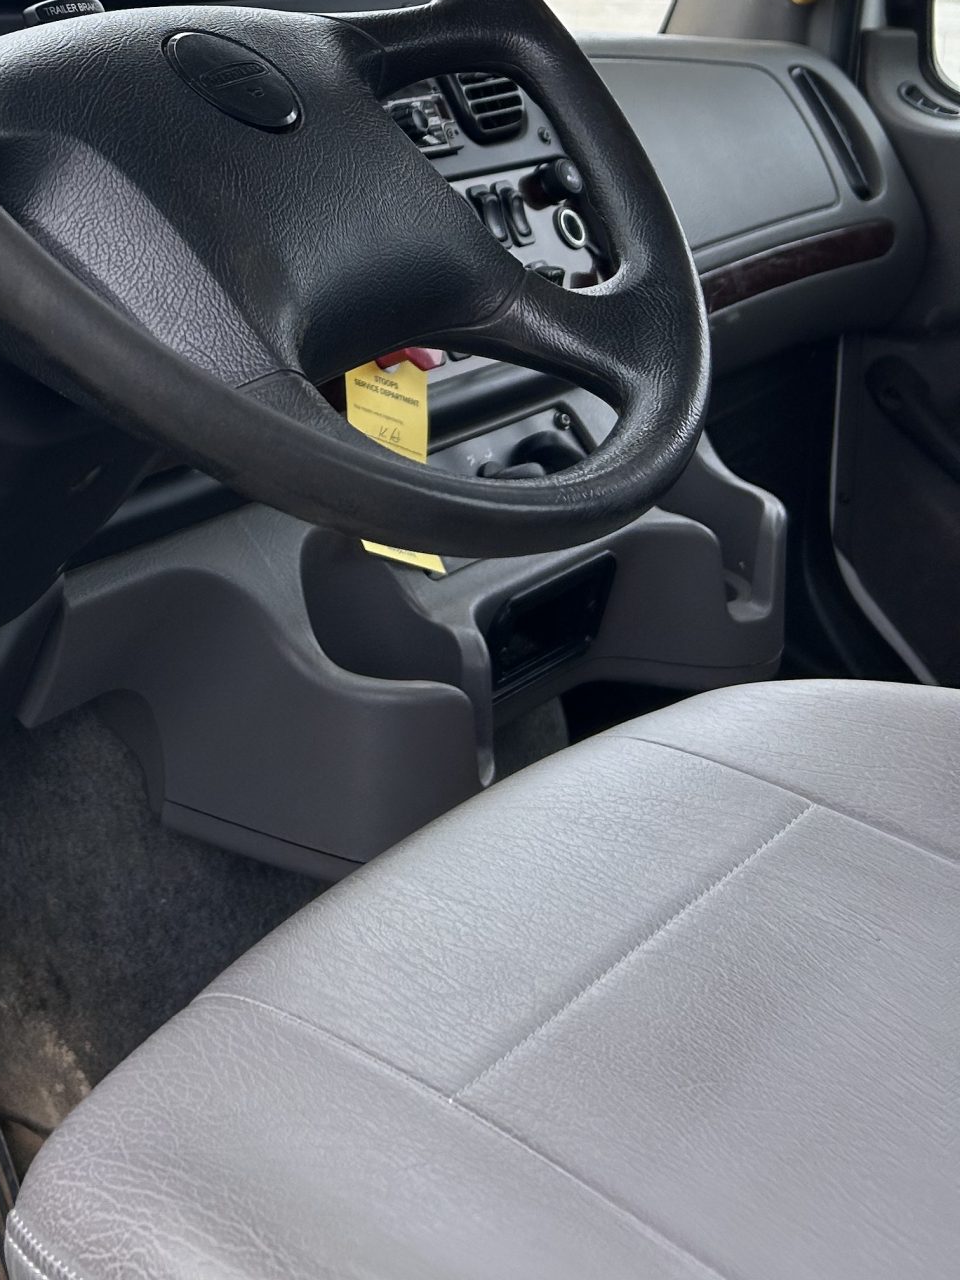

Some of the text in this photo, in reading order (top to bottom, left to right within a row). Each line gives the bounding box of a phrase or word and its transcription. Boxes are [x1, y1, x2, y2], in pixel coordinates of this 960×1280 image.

[44, 3, 77, 16] TRAILER
[354, 378, 420, 407] SERVICE DEPARTMENT
